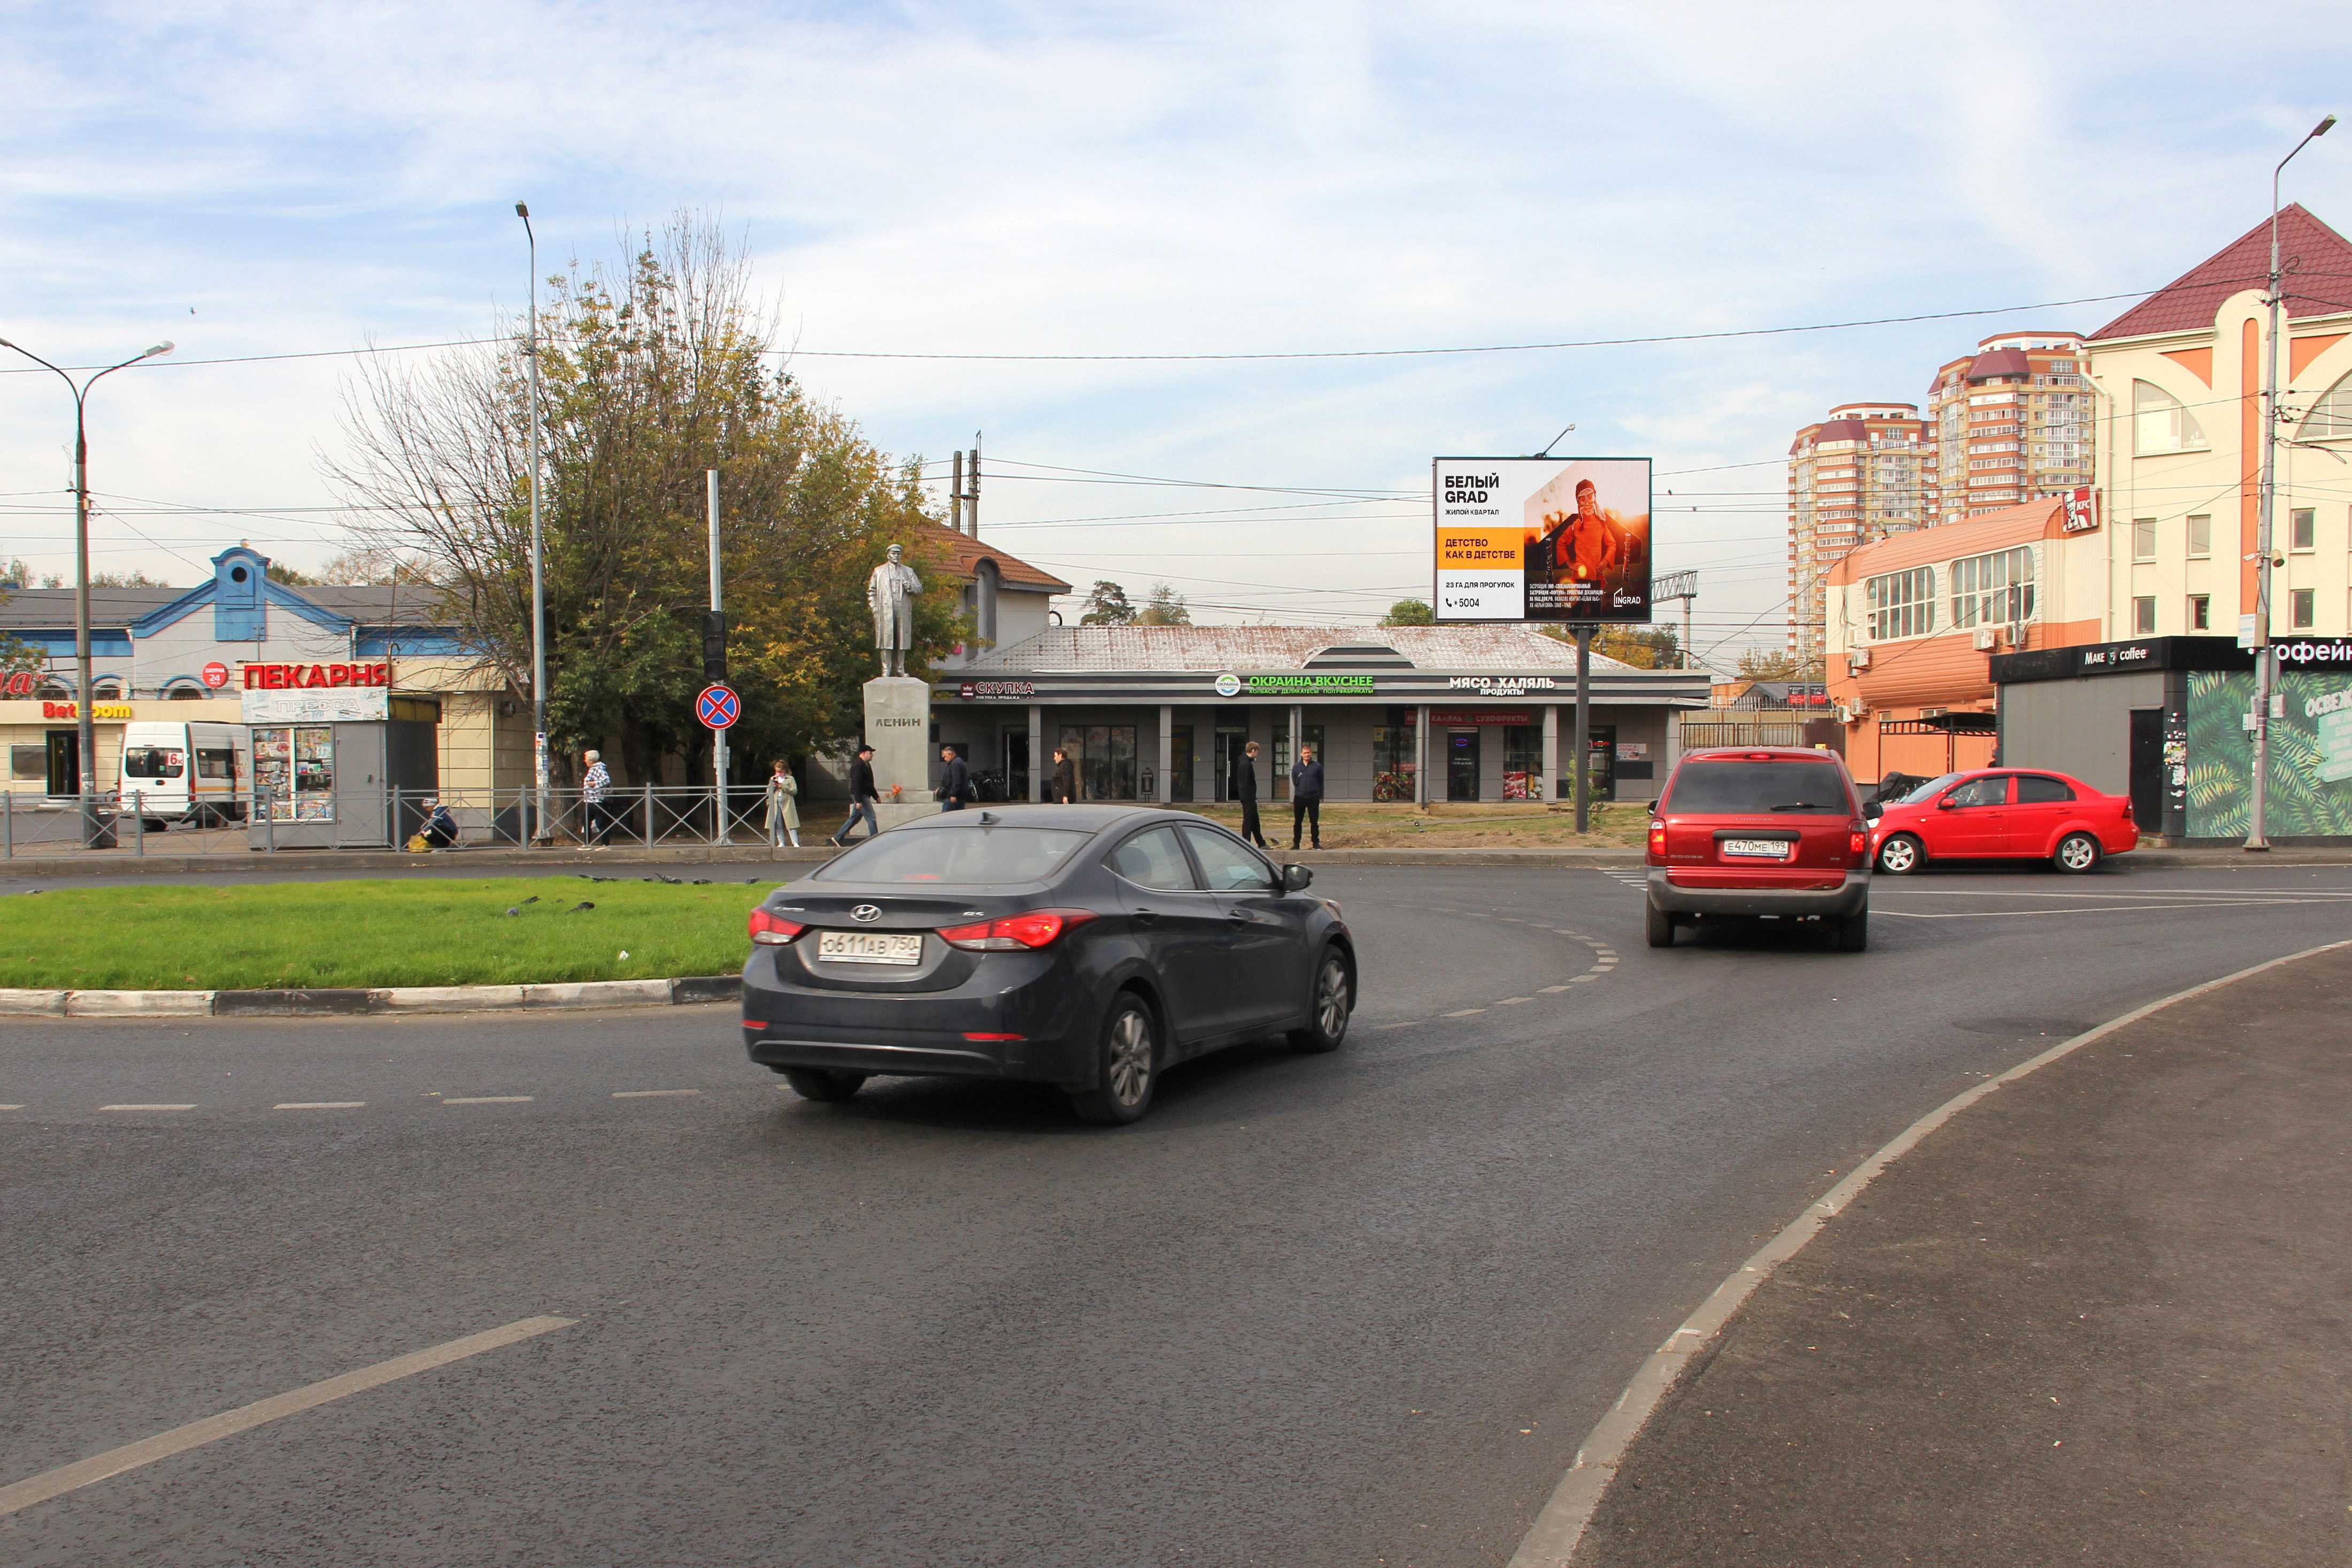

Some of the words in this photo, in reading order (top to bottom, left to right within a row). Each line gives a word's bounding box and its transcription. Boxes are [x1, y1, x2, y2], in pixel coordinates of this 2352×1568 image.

[1445, 473, 1499, 488] БЕЛЫЙ
[1445, 491, 1488, 503] GRAD
[2076, 499, 2091, 511] KFC
[1445, 539, 1488, 547] ДЕТСТВО
[1446, 551, 1464, 559] КАК
[1466, 551, 1472, 559] В
[1474, 551, 1515, 559] ДЕТСТВЕ
[2119, 647, 2147, 660] coffee
[244, 663, 392, 690] ПЕКАРНЯ
[1249, 676, 1311, 686] ОКРАИНА
[1315, 676, 1374, 686] ВКУСНЕЕ
[976, 682, 1035, 694] СКУПКА
[1449, 677, 1491, 689] МЯСО
[1497, 677, 1556, 689] ХАЛЯЛЬ
[43, 701, 132, 719] Betoom
[277, 698, 361, 713] ПРЕССА
[875, 718, 921, 727] ЛЕНИН
[1728, 840, 1768, 852] Е470МЕ
[1770, 841, 1785, 849] 199
[824, 935, 886, 954] О611АВ
[891, 936, 916, 950] 750
